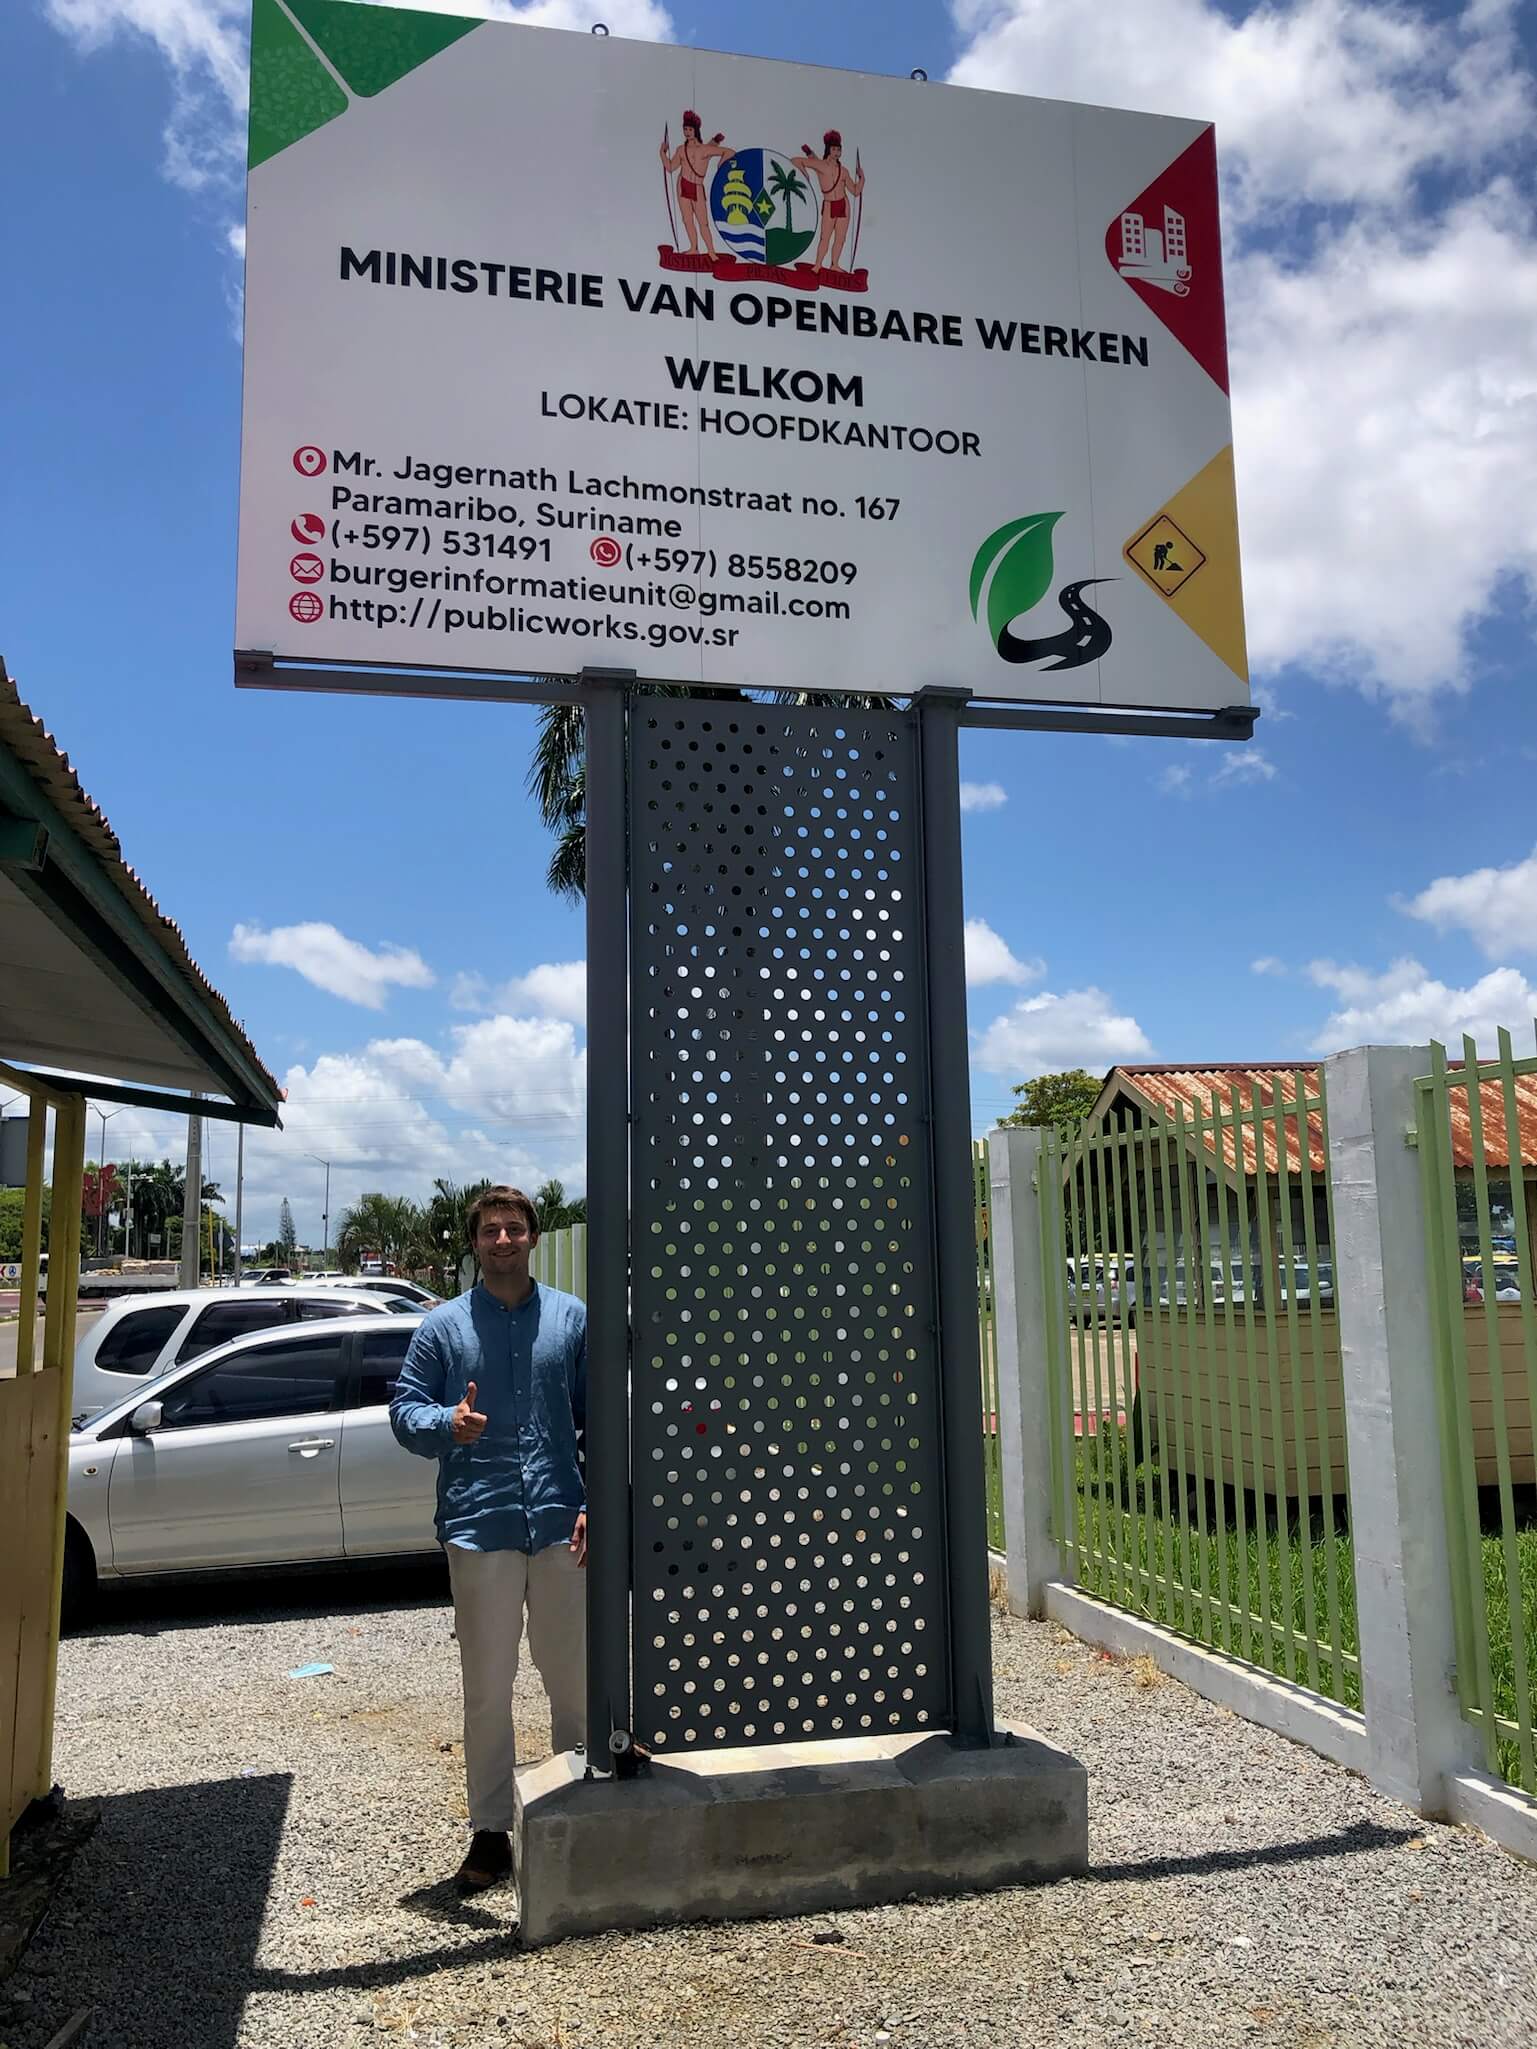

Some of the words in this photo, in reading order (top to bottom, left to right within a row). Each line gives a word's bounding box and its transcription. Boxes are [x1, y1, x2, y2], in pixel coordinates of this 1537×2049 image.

[341, 247, 603, 311] MINISTERIE
[618, 279, 713, 320] VAN
[730, 293, 962, 346] OPENBARE
[975, 318, 1149, 366] WERKEN
[665, 356, 864, 407] WELKOM
[542, 392, 687, 430] LOKATIE:
[701, 408, 981, 456] HOOFDKANTOOR
[332, 486, 525, 527] Paramaribo,
[536, 502, 681, 537] Suriname
[333, 450, 382, 478] Mr.
[394, 456, 557, 491] Jagernath
[569, 470, 791, 512] Lachmonstraat
[803, 498, 845, 517] no.
[855, 497, 899, 520] 167
[331, 519, 430, 555] (+597)
[443, 530, 550, 562] 531491
[625, 542, 717, 578] (+597)
[729, 553, 858, 584] 8558209
[330, 558, 850, 620] burgerinformatieunit@gmail.com
[328, 595, 740, 648] http://publicworks.gov.sr
